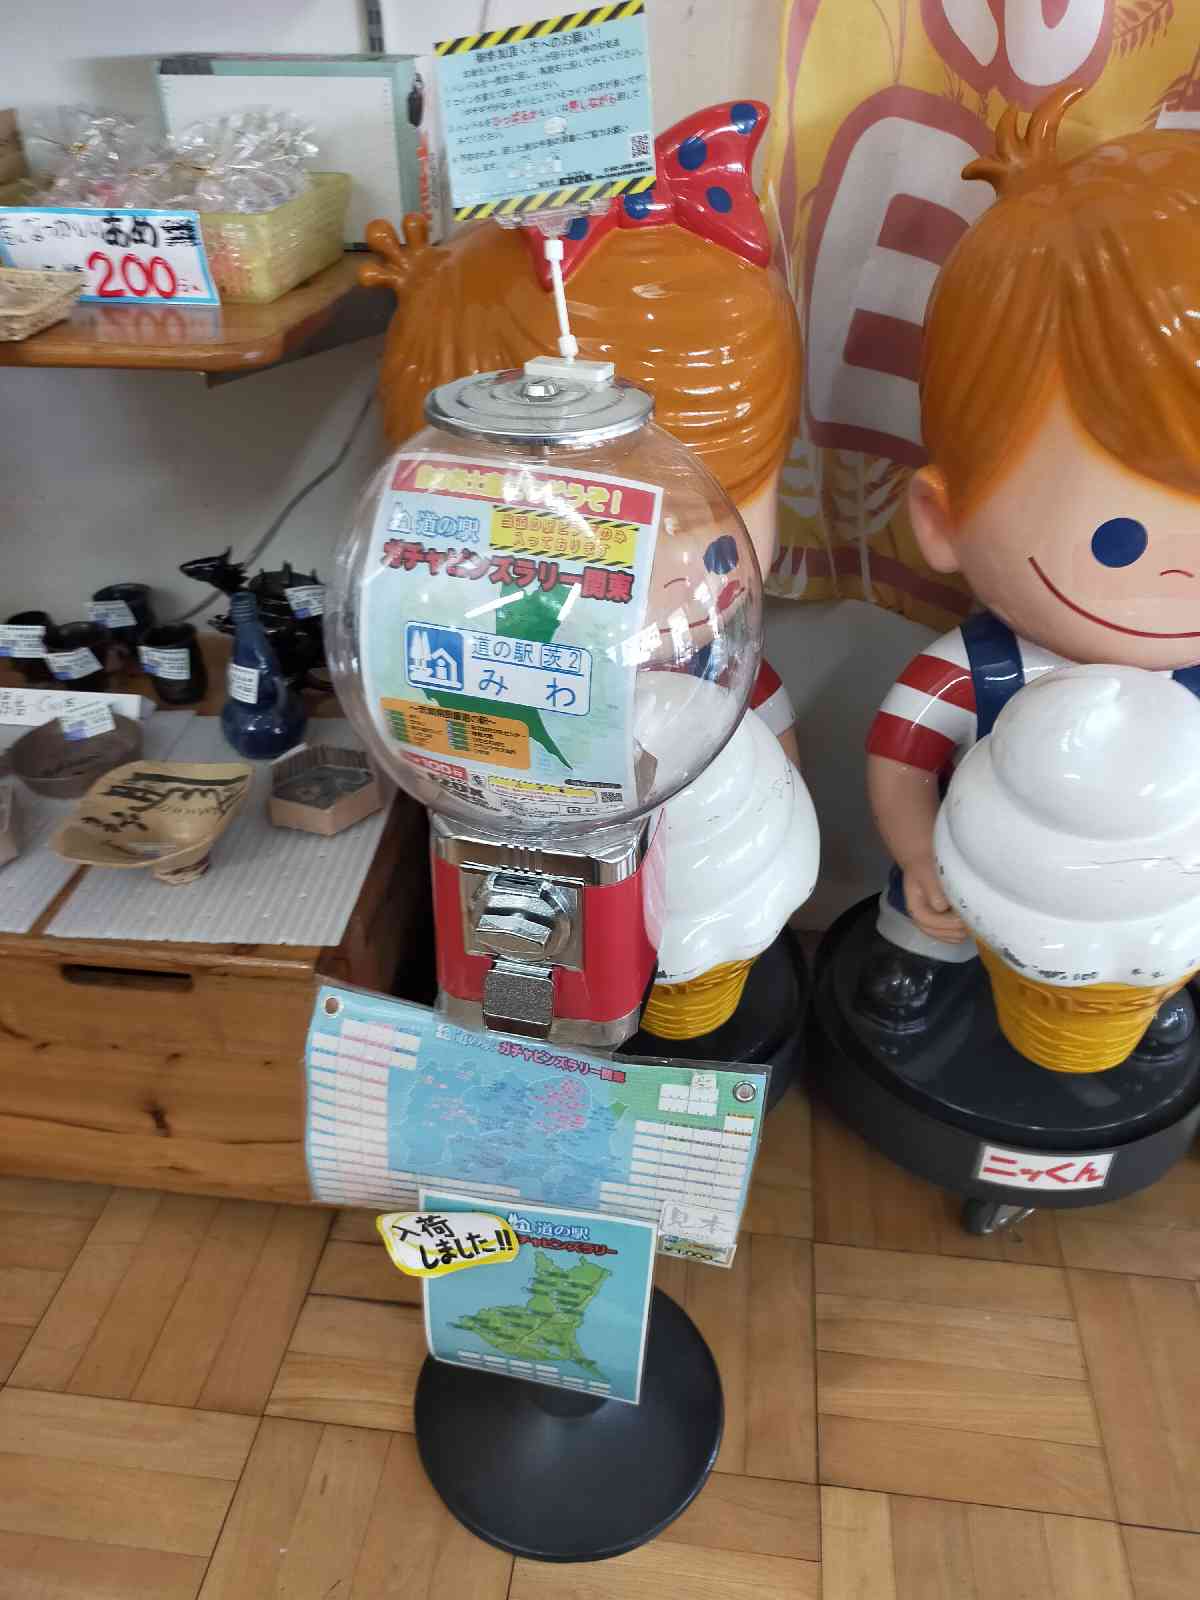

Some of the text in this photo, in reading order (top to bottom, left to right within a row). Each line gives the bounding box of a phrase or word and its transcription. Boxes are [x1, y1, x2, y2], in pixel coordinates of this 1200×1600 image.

[471, 635, 535, 664] 道の駅
[392, 1214, 455, 1242] 入荷
[534, 1219, 592, 1242] 道の駅
